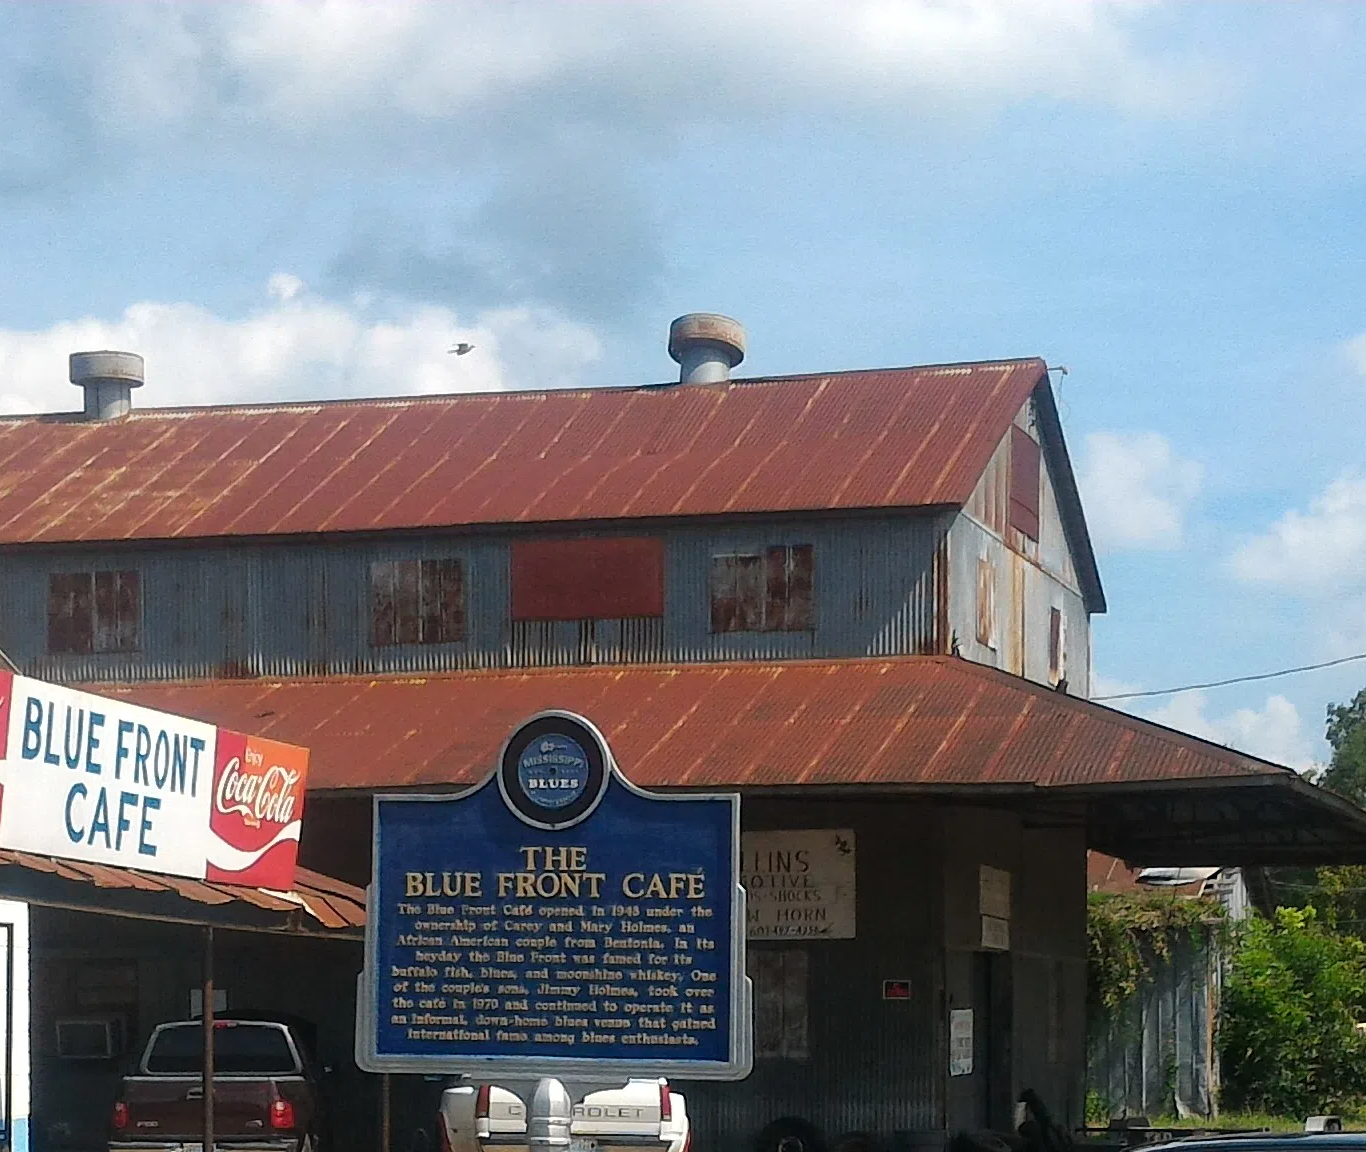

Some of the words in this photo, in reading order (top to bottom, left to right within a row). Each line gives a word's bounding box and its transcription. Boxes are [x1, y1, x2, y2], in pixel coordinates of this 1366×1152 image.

[21, 697, 106, 776] BLUE
[114, 719, 205, 798] FRONT
[245, 747, 263, 767] Enjoy
[522, 754, 584, 768] MISSISSIPPI
[217, 757, 301, 824] Coca-Cola
[528, 778, 579, 789] BLUES
[65, 782, 162, 858] CAFE
[519, 846, 588, 872] THE
[405, 871, 483, 898] BLUE
[497, 872, 606, 898] FRONT
[622, 867, 706, 899] CAFÉ
[397, 903, 422, 915] The
[427, 904, 455, 915] Blue
[461, 904, 496, 915] Front
[539, 905, 585, 918] opened
[592, 905, 605, 917] in
[646, 906, 684, 917] under
[691, 906, 713, 918] the
[415, 920, 477, 933] ownership
[483, 920, 498, 931] of
[549, 921, 573, 932] and
[580, 921, 613, 934] Mary
[679, 924, 695, 934] an
[396, 934, 443, 947] African
[450, 935, 509, 947] American
[515, 936, 557, 949] couple
[565, 937, 596, 948] from
[674, 937, 688, 949] In
[697, 938, 715, 949] its
[415, 950, 462, 963] heyday
[469, 951, 491, 962] the
[496, 951, 525, 963] Blue
[530, 952, 566, 963] Front
[573, 954, 596, 964] was
[603, 953, 642, 965] famed
[648, 953, 668, 965] for
[674, 954, 693, 965] its
[391, 965, 438, 978] buffalo
[525, 968, 549, 979] and
[556, 969, 623, 981] moonshine
[691, 970, 717, 982] One
[393, 981, 410, 993] of
[414, 982, 436, 993] the
[537, 984, 581, 996] Jimmy
[647, 985, 679, 997] took
[685, 987, 715, 998] over
[392, 997, 414, 1009] the
[453, 998, 466, 1010] in
[473, 998, 499, 1010] 1970
[504, 999, 529, 1011] and
[535, 1000, 597, 1012] continued
[603, 1001, 618, 1012] to
[624, 1001, 674, 1014] operate
[680, 1002, 694, 1014] it
[700, 1003, 715, 1014] as
[391, 1014, 407, 1025] an
[555, 1016, 589, 1027] blues
[594, 1018, 631, 1028] venue
[638, 1016, 667, 1029] that
[671, 1017, 717, 1031] gained
[407, 1028, 491, 1042] international
[496, 1030, 528, 1042] fame
[534, 1033, 575, 1045] among
[581, 1031, 616, 1043] blues
